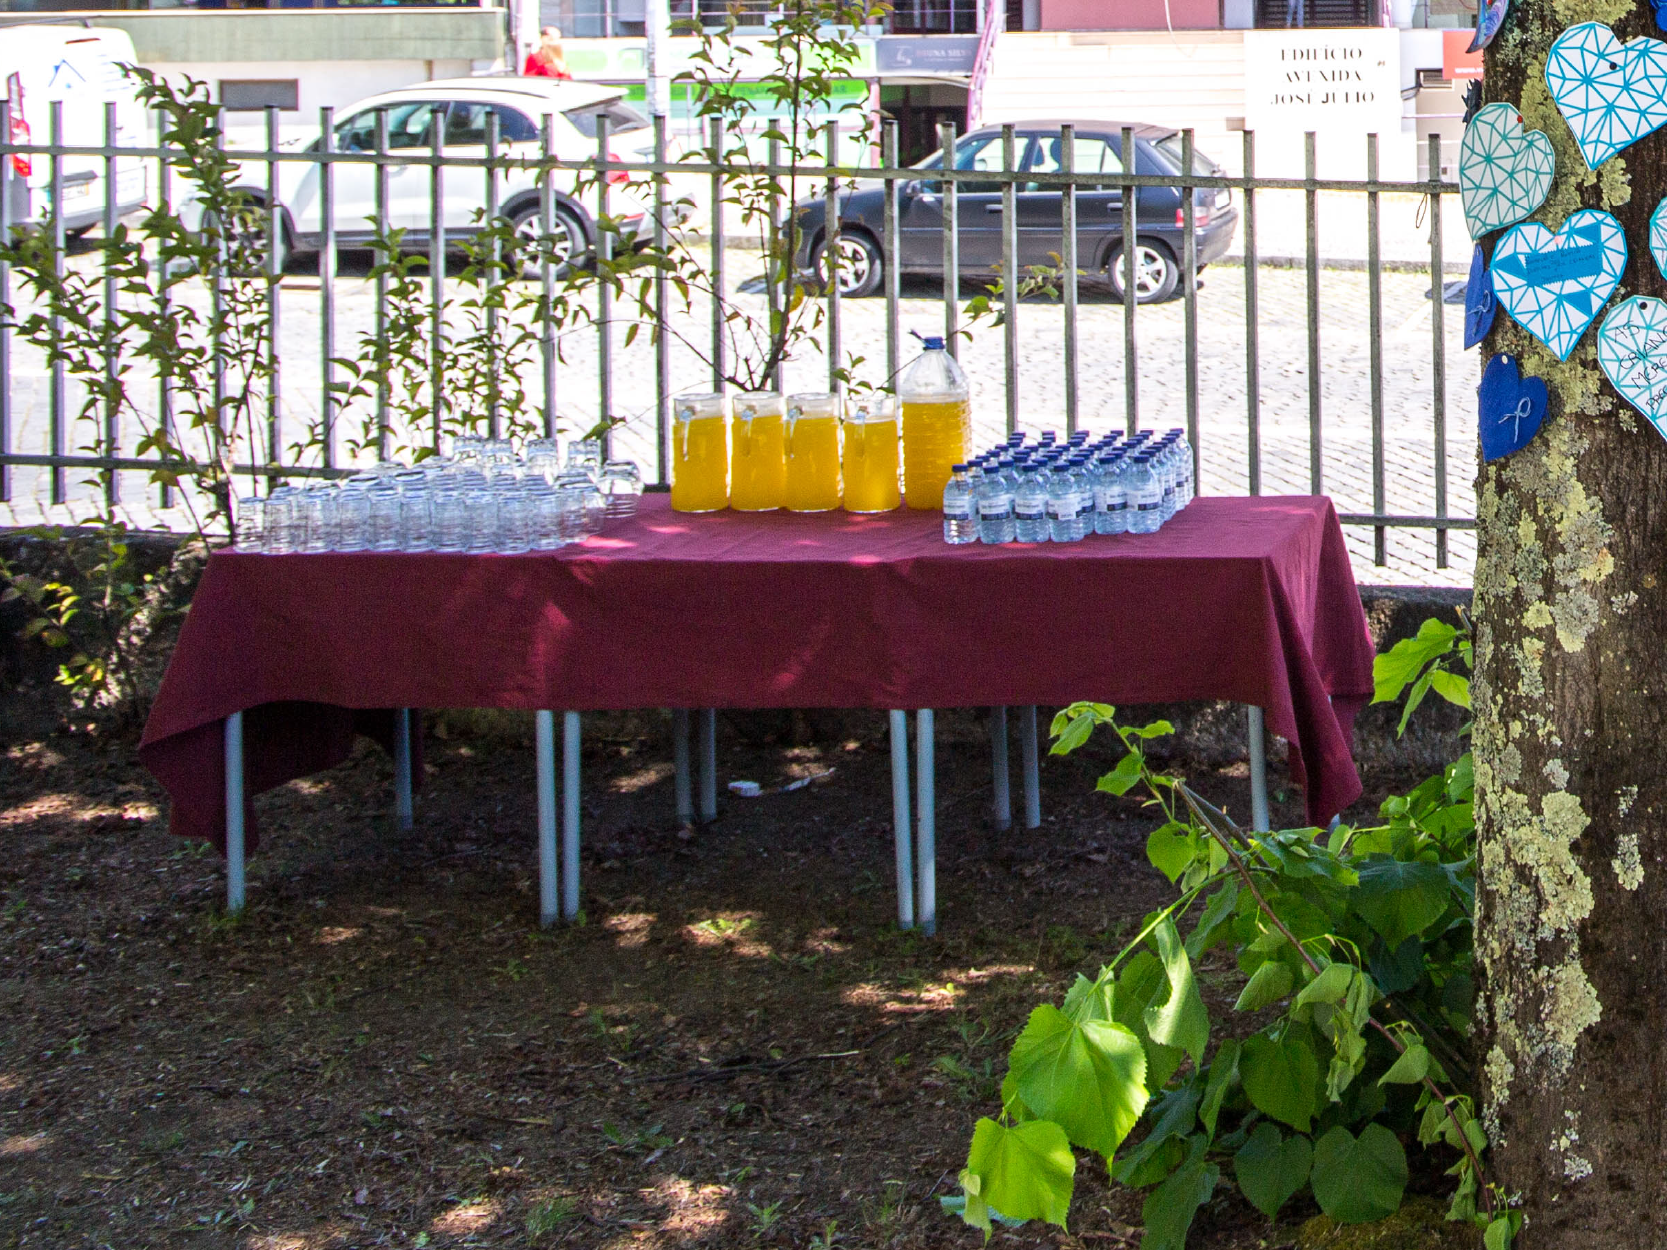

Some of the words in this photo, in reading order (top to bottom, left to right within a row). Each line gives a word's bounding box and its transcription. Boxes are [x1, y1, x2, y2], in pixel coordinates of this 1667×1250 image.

[1281, 44, 1362, 61] EDIFÍCIO
[1283, 69, 1362, 83] AVENIDA
[1270, 88, 1314, 105] JOSÉ
[1321, 88, 1375, 104] JÚLIO
[1614, 320, 1640, 343] AS
